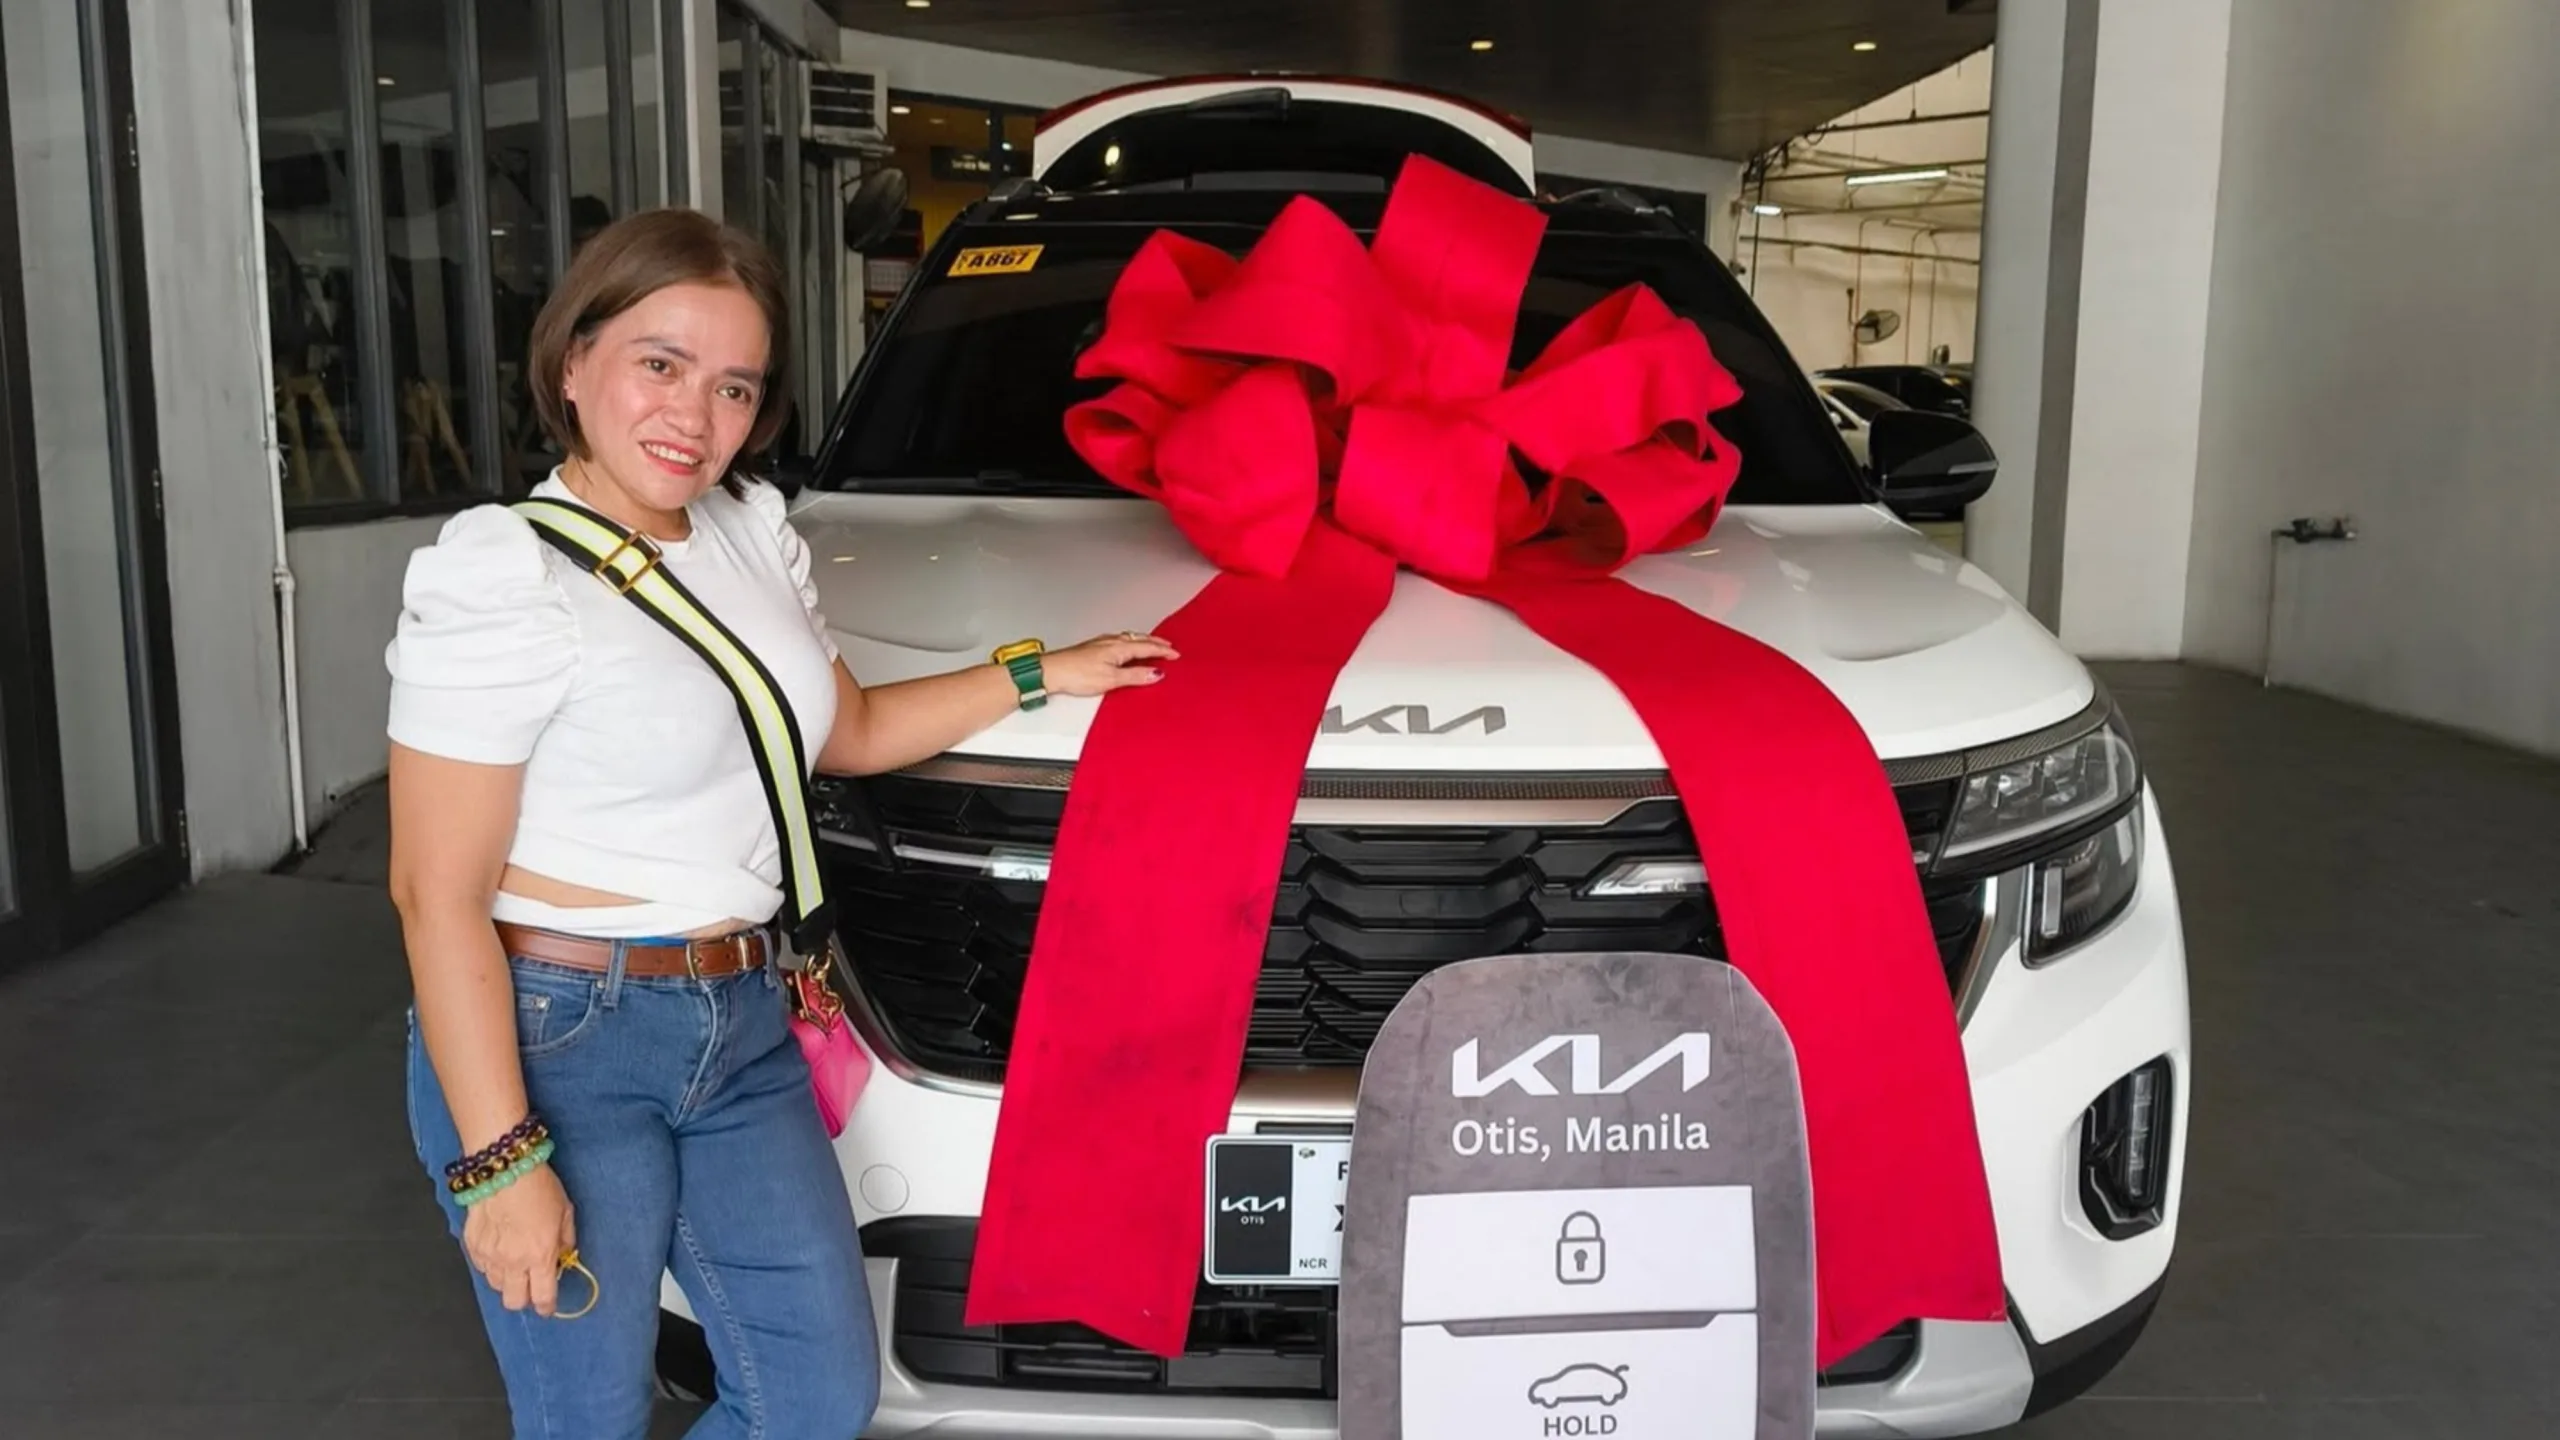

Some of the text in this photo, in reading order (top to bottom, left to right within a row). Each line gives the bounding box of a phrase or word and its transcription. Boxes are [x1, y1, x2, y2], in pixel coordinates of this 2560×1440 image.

[1321, 705, 1507, 736] KIA
[1451, 1032, 1711, 1098] KIA
[1452, 1113, 1710, 1163] Otis, Manila
[1220, 1195, 1287, 1212] KIA
[1240, 1215, 1266, 1226] OTIS
[1298, 1258, 1328, 1269] NCR
[1543, 1414, 1618, 1438] HOLD
